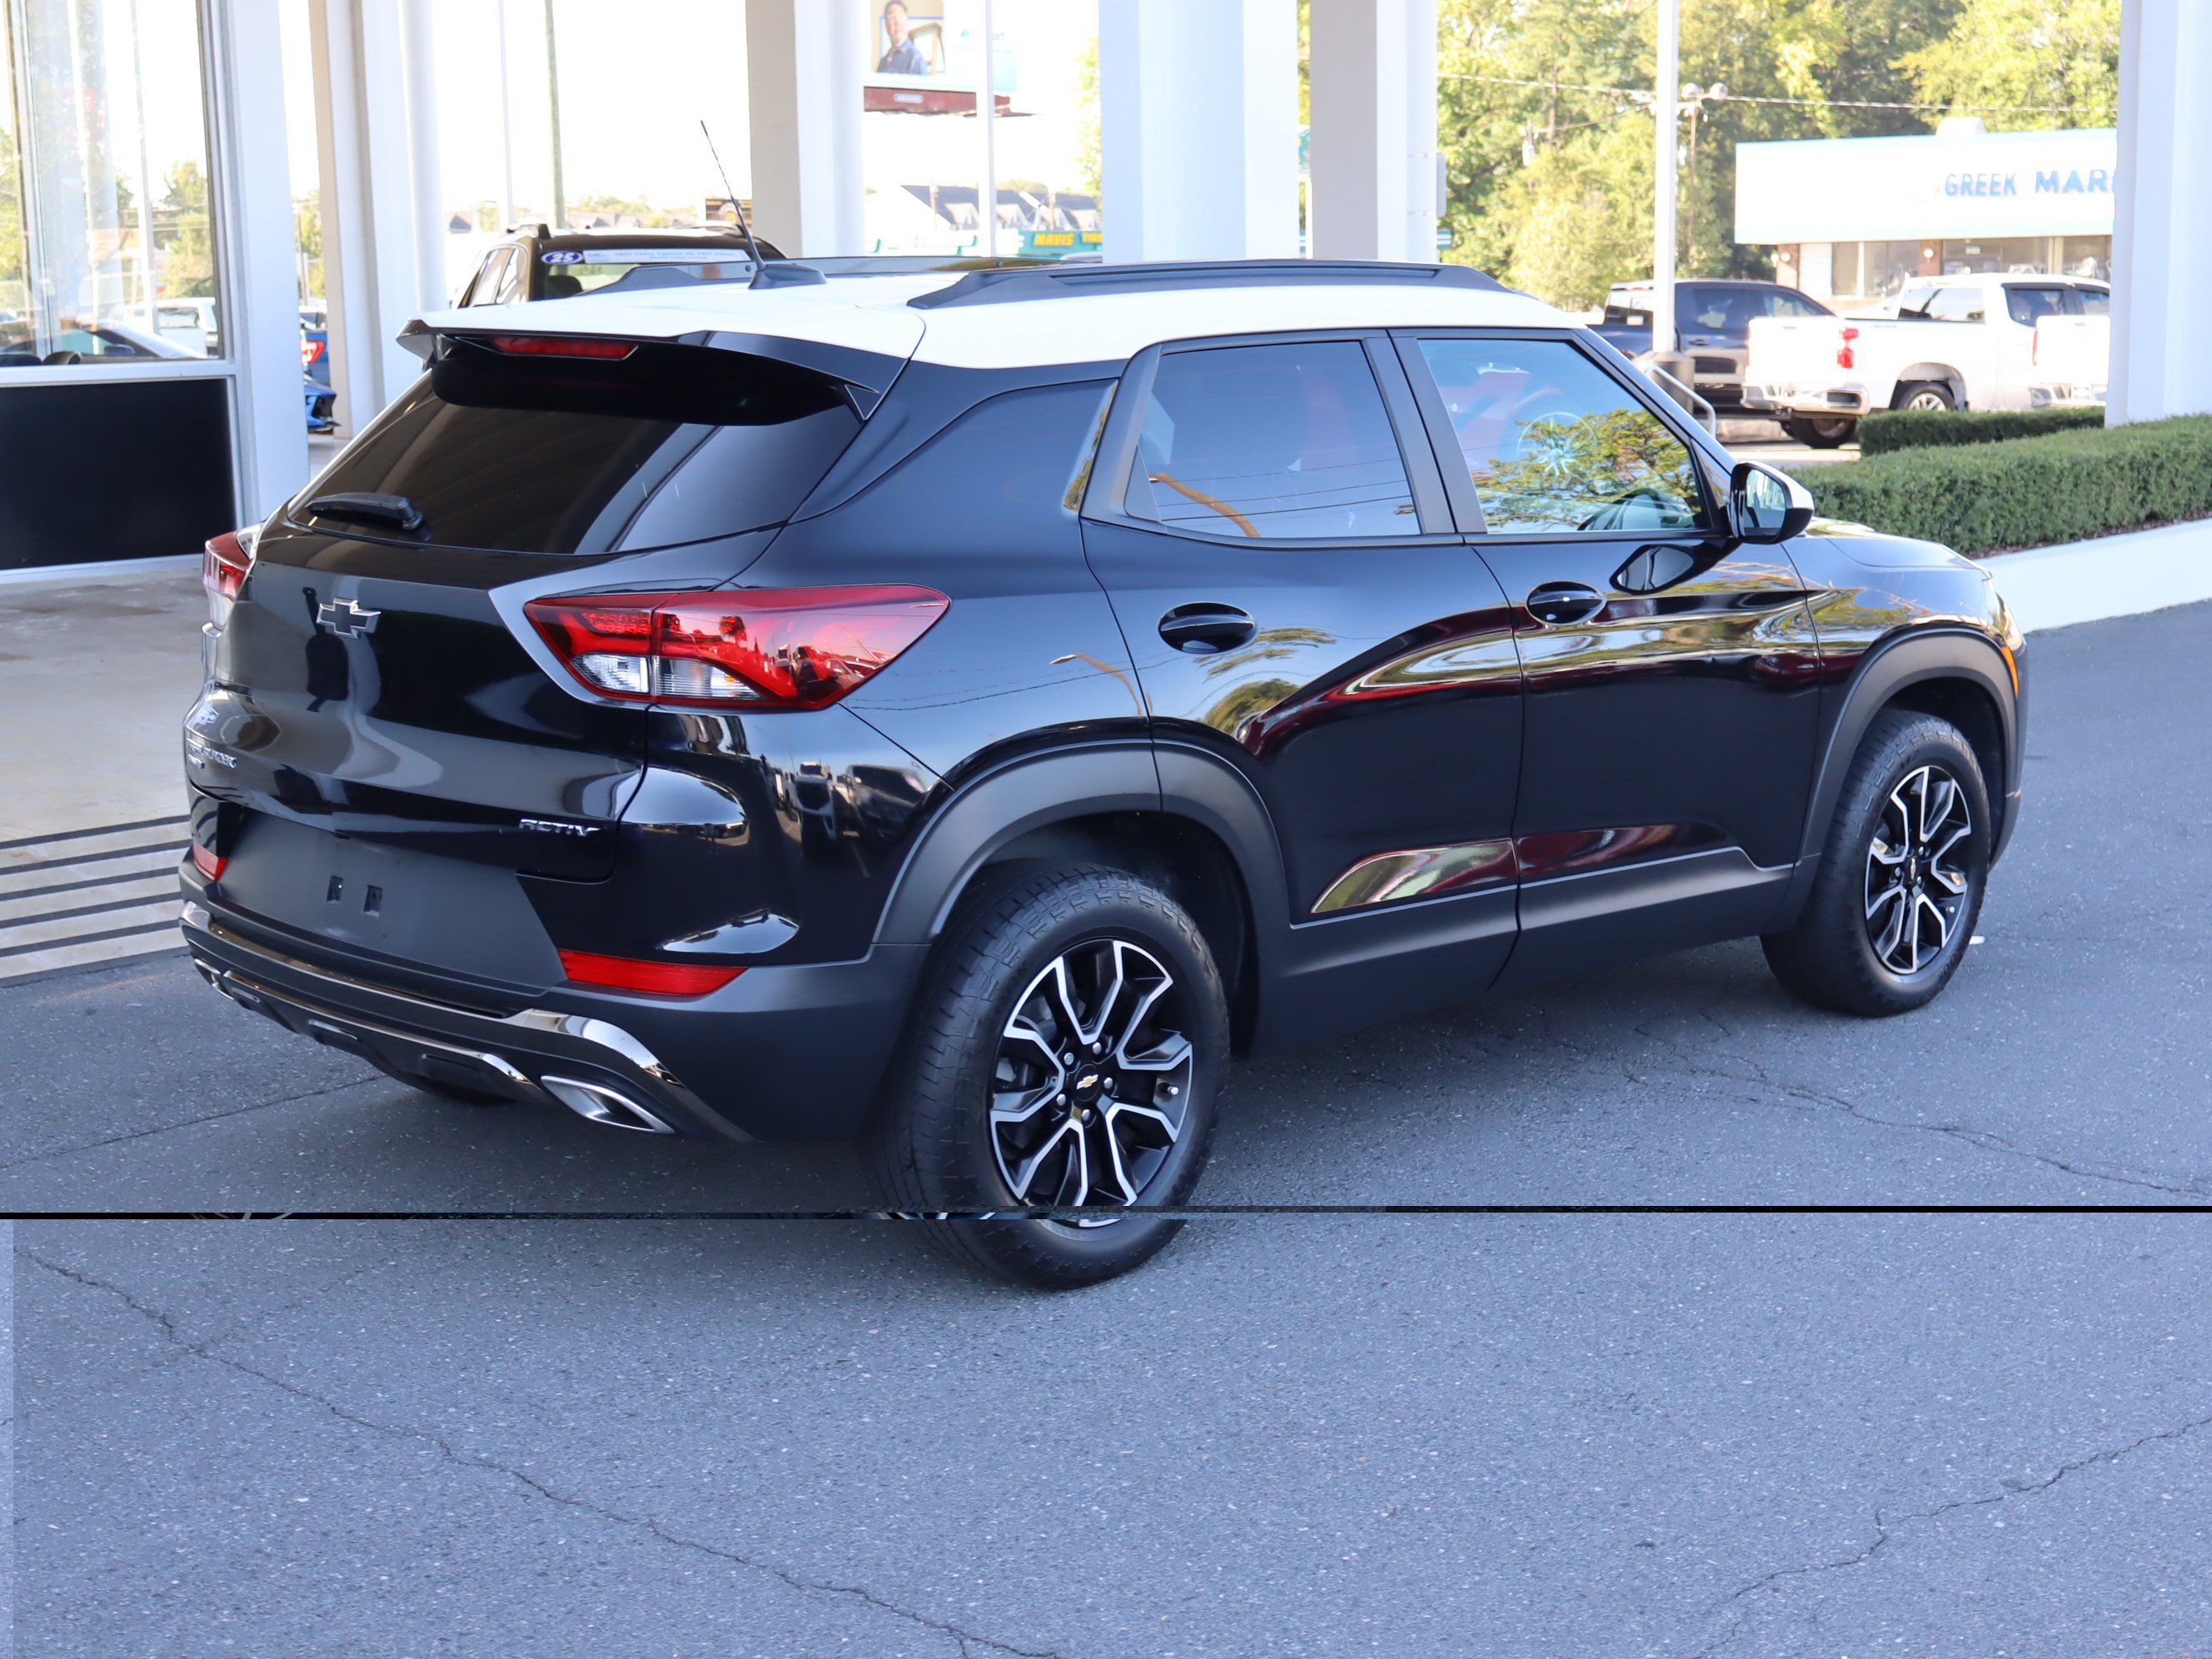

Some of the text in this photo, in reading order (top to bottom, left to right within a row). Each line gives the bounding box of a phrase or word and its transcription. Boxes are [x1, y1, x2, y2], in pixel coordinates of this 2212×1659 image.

[1945, 169, 2116, 197] GREEK MAR
[551, 252, 575, 263] 25
[518, 819, 600, 837] ACTIV
